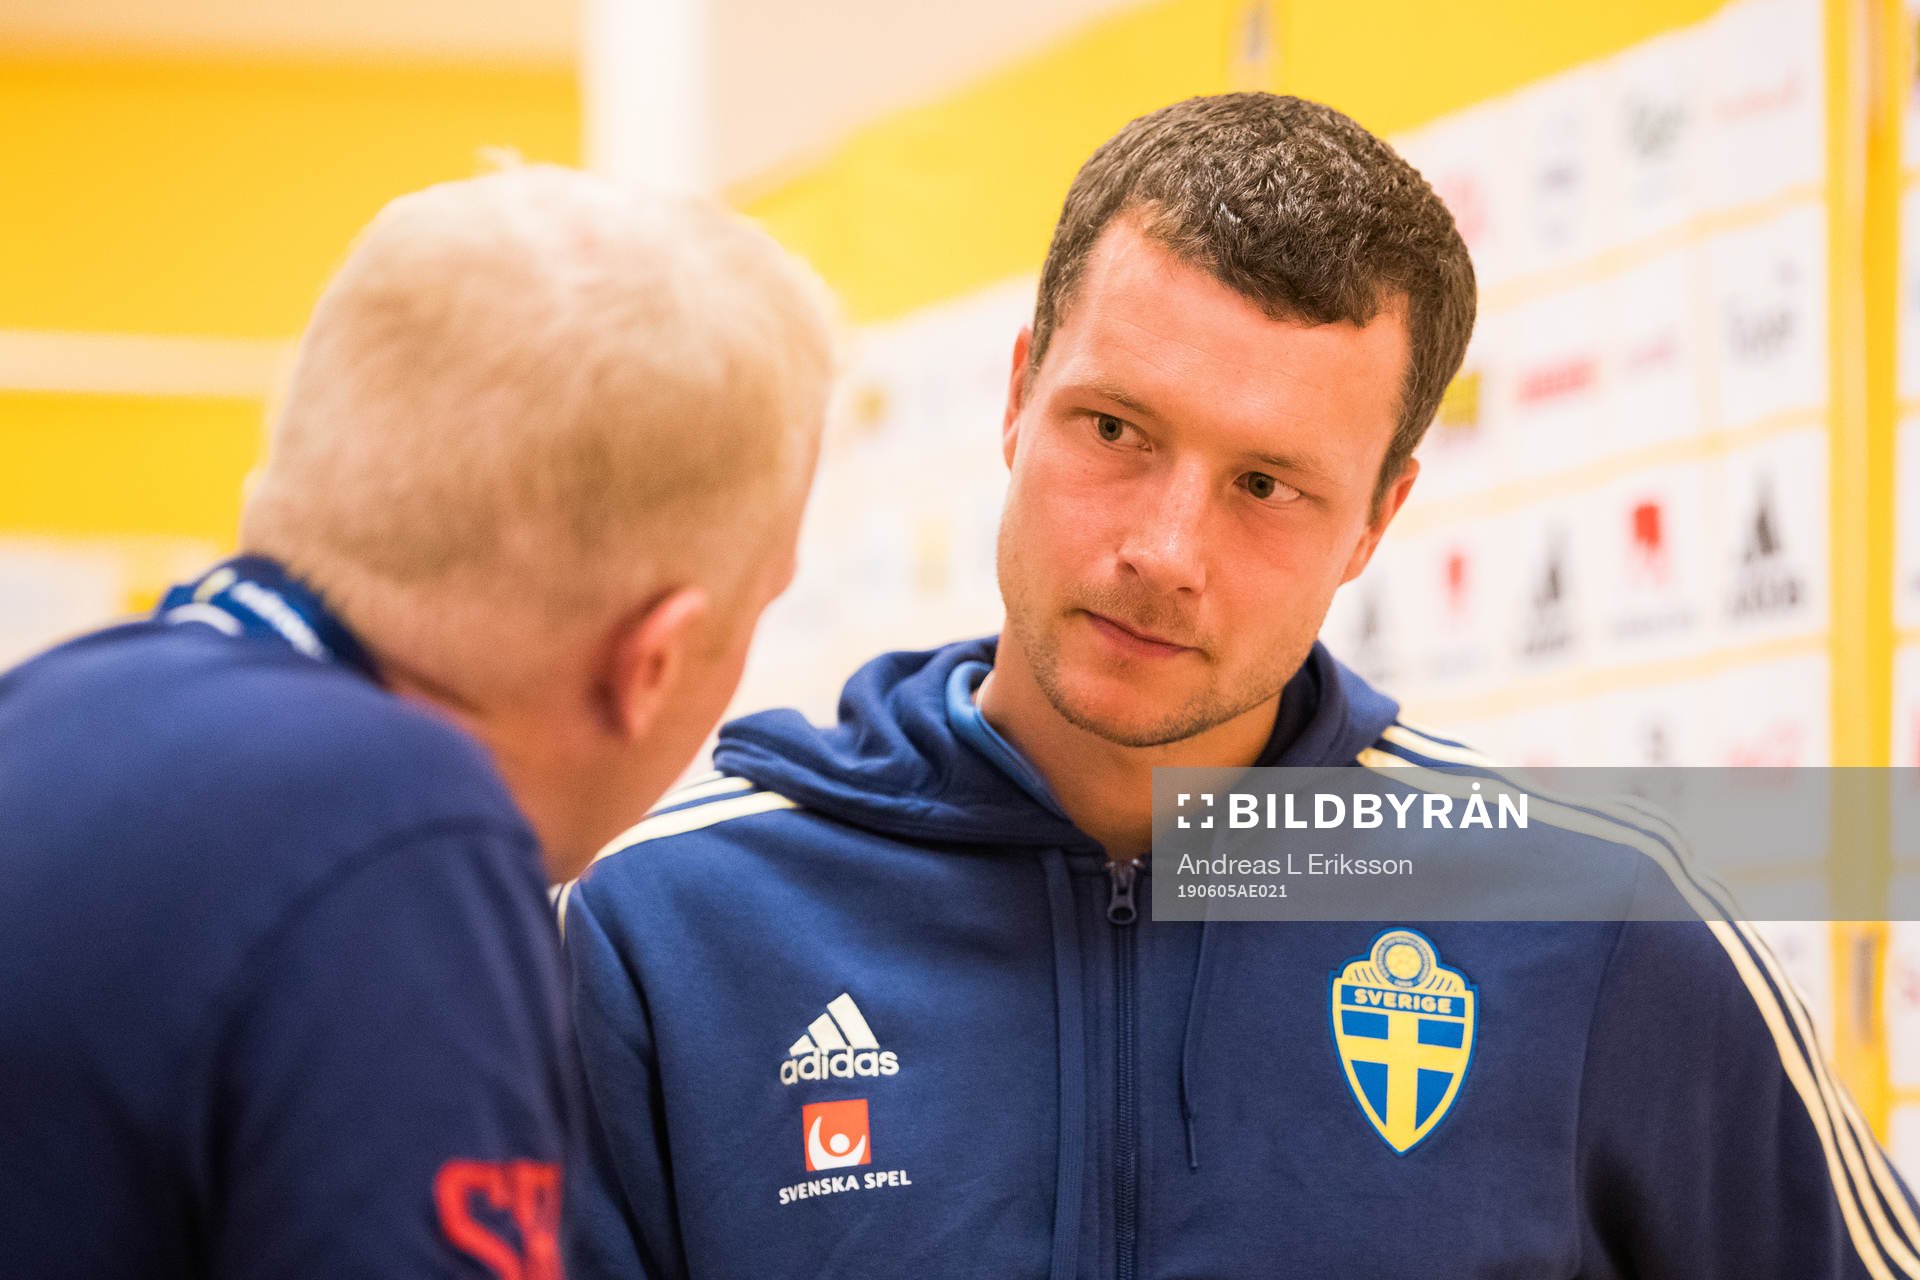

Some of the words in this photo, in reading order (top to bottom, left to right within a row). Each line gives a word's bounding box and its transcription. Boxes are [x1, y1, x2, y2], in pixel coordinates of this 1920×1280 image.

[1353, 988, 1453, 1014] SVERIGE
[780, 1047, 900, 1086] adidas
[778, 1174, 860, 1205] SVENSKA
[863, 1169, 912, 1191] SPEL
